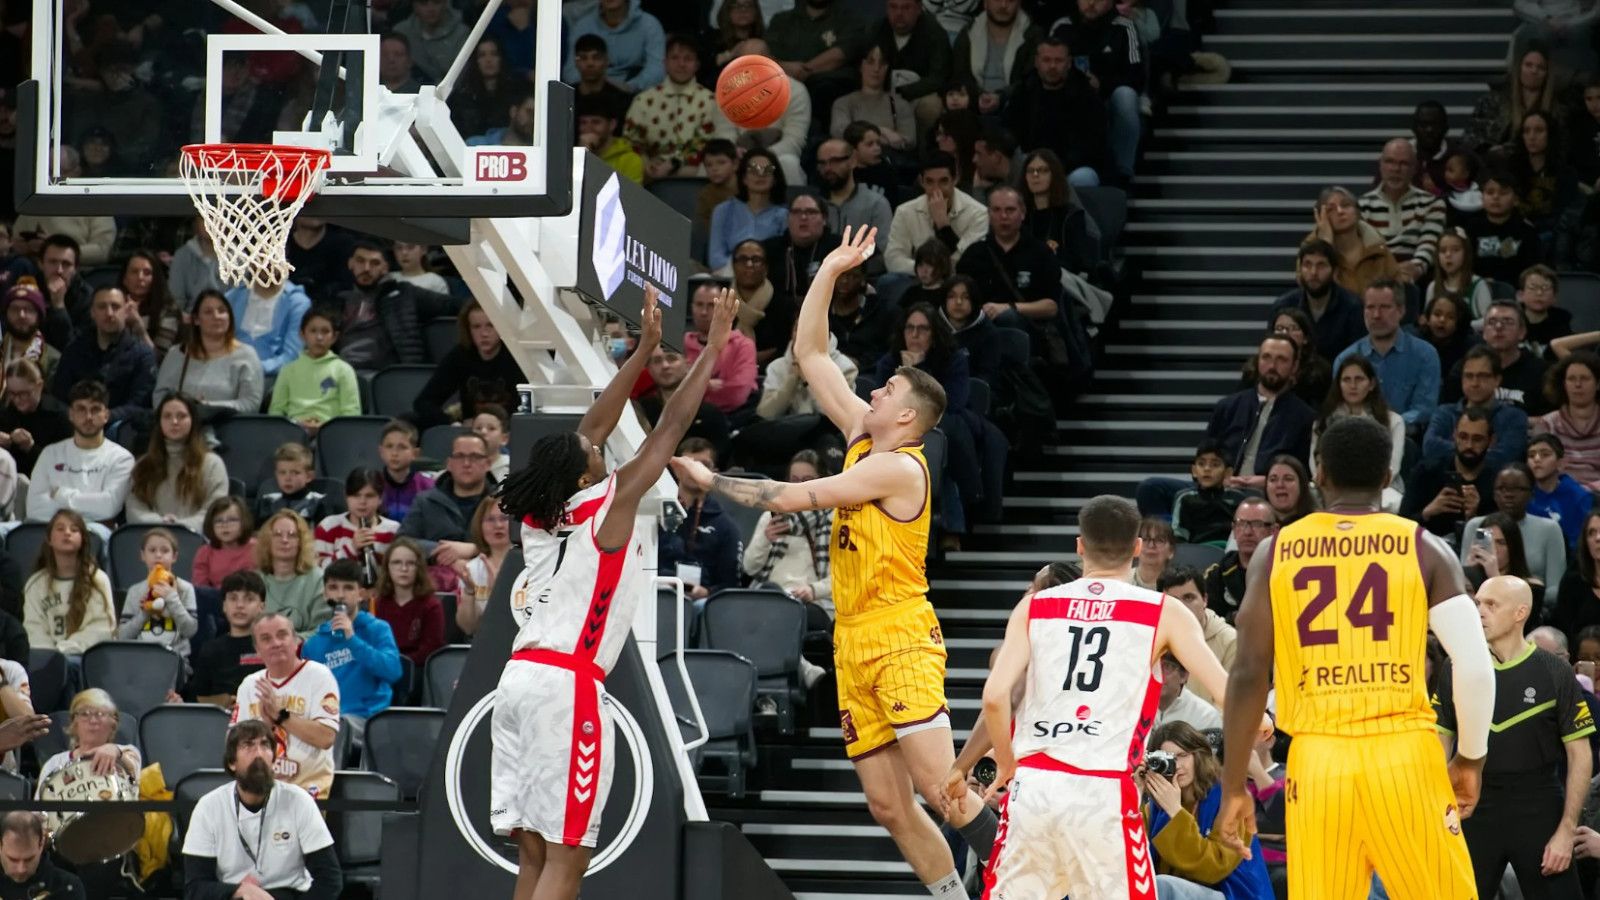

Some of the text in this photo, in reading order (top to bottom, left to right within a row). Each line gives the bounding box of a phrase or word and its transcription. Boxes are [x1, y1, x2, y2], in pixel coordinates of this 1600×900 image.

[648, 249, 678, 293] IMMO
[1280, 533, 1409, 562] HOUMOUNOU
[1066, 599, 1118, 620] FALCOZ
[1292, 561, 1395, 648] 24
[1062, 625, 1111, 692] 13
[1316, 662, 1411, 687] REALITES
